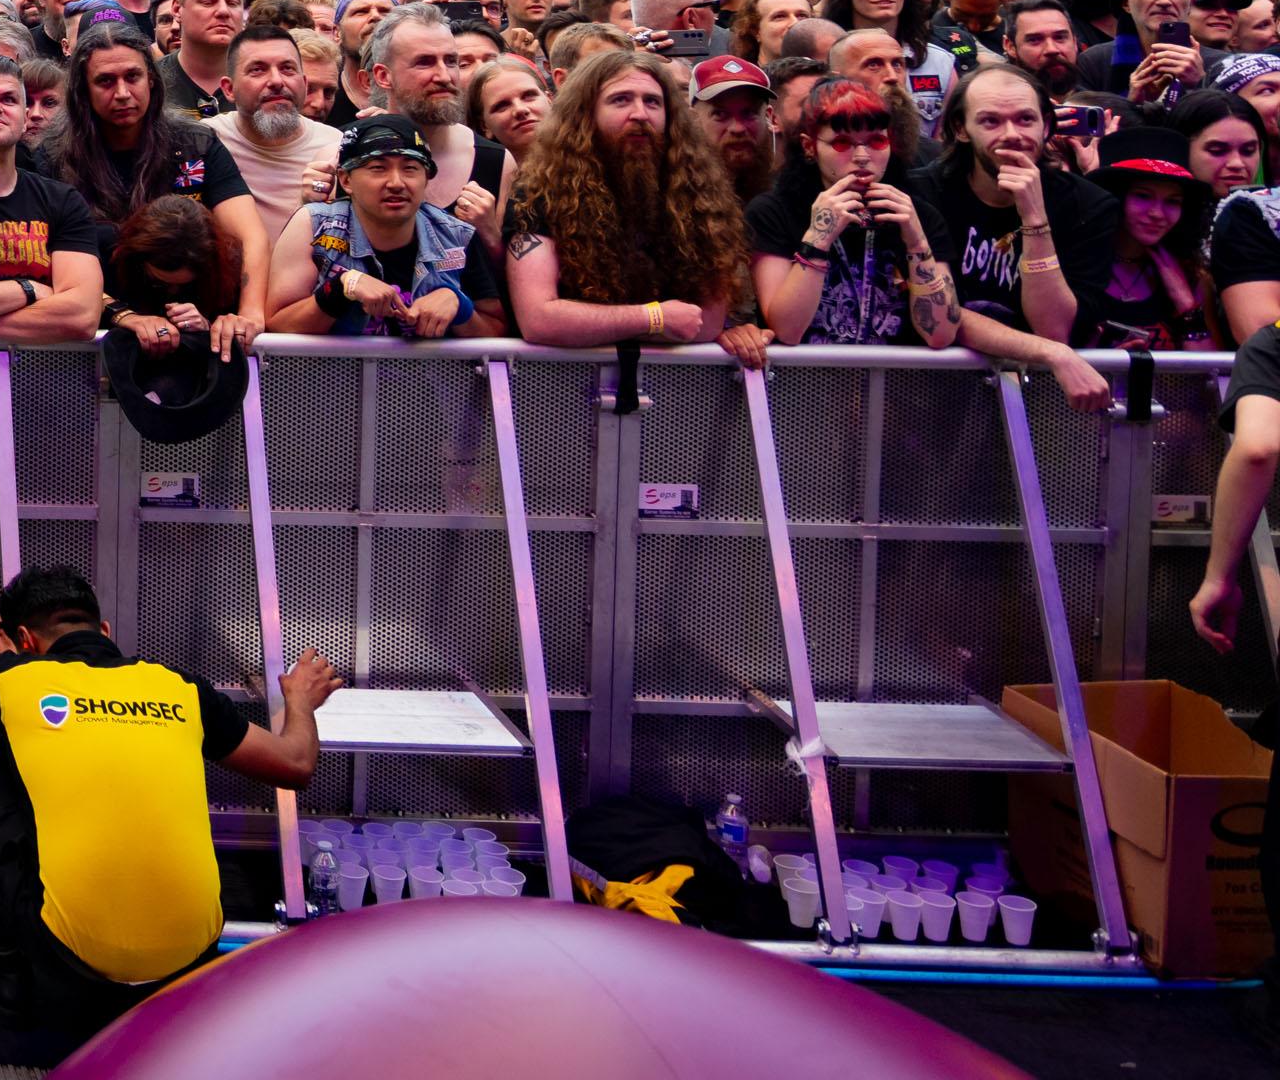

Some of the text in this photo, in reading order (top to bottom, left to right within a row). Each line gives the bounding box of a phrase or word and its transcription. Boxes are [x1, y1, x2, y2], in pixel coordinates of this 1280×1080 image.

[161, 479, 177, 488] eps
[74, 697, 187, 723] SHOWSEC
[111, 717, 168, 728] Management
